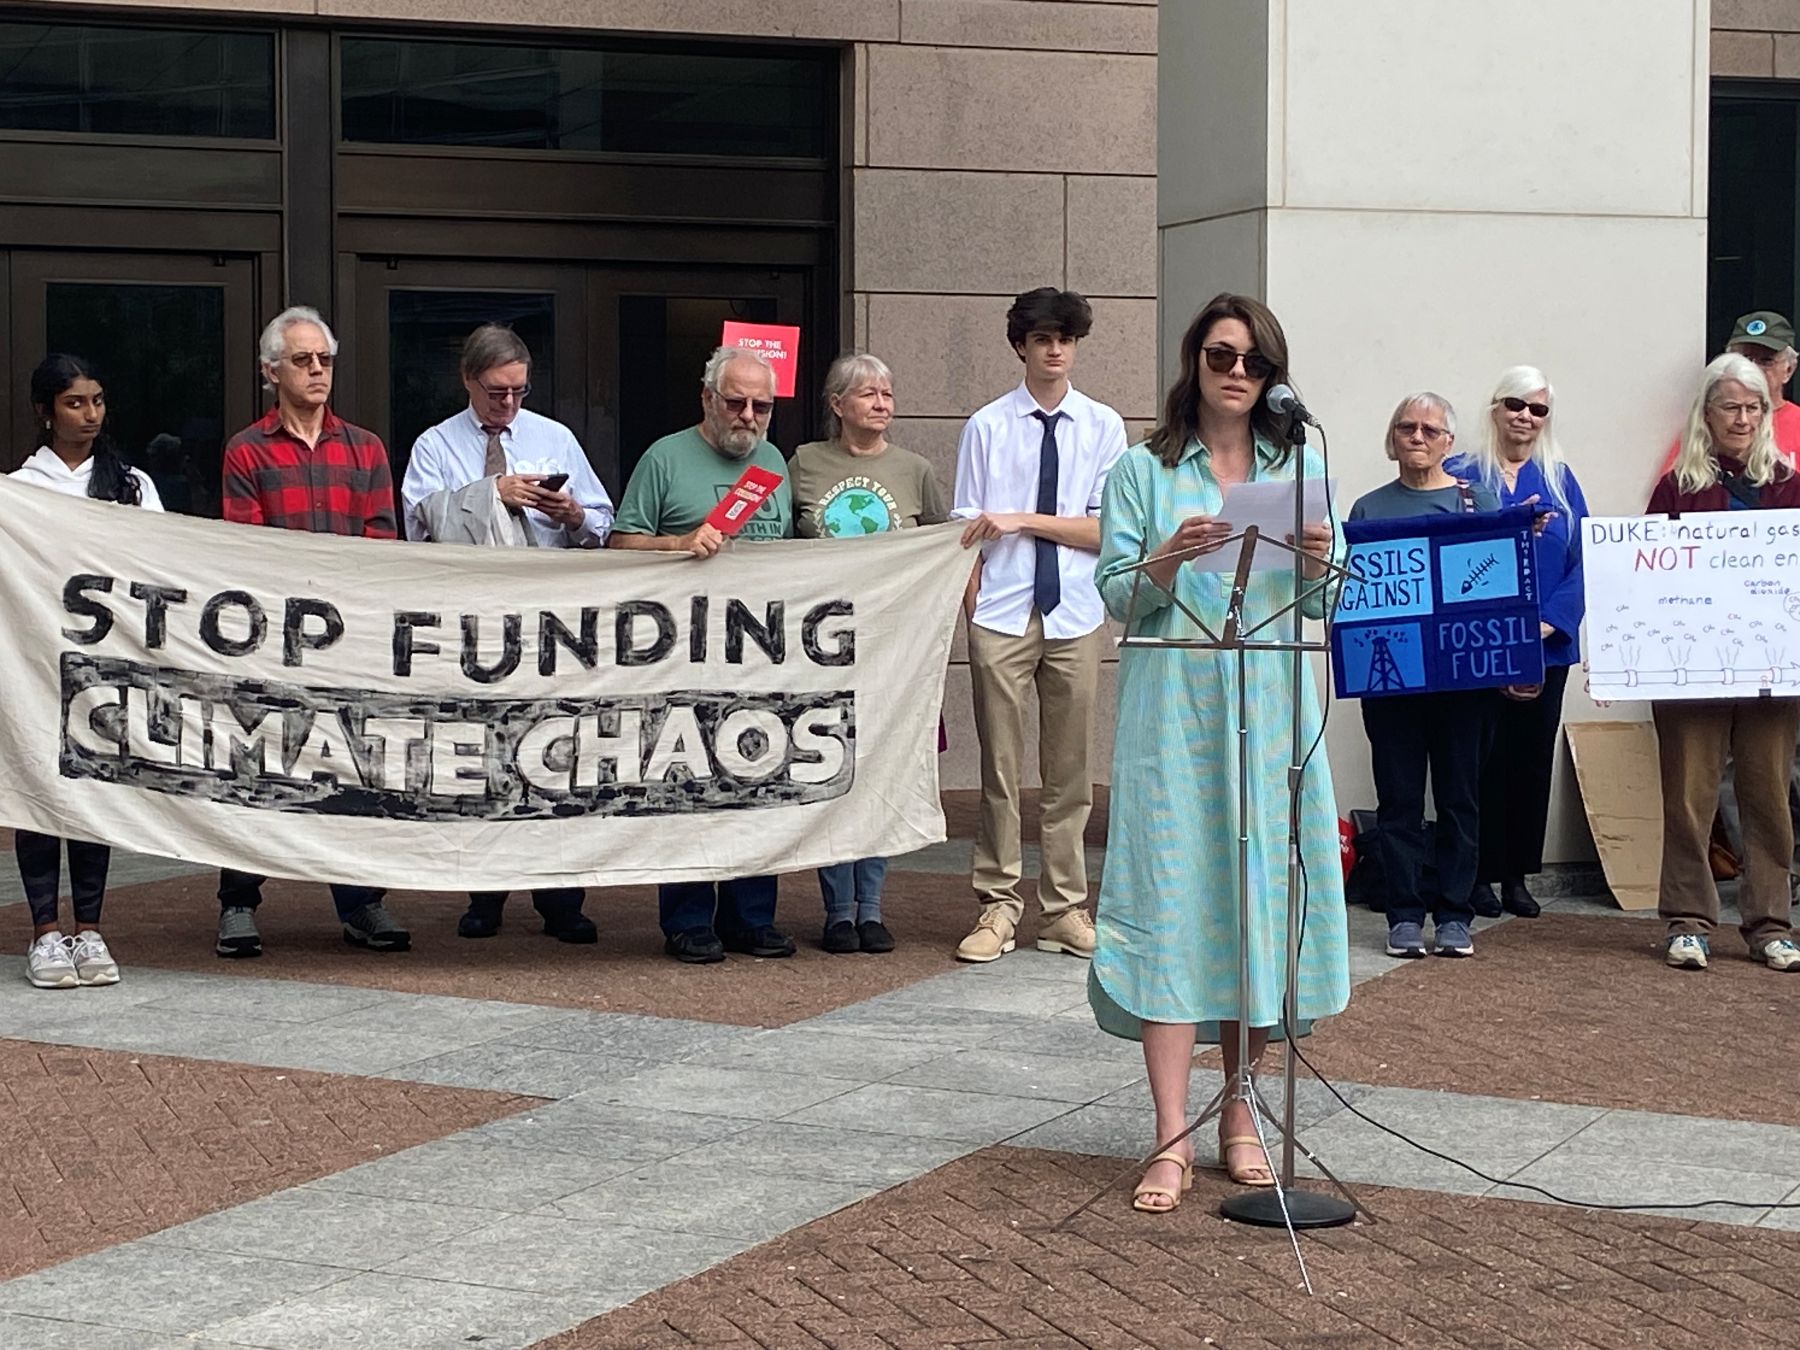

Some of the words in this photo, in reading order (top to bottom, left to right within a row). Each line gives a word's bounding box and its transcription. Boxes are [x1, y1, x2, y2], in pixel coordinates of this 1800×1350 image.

[738, 338, 763, 347] STOP
[765, 340, 782, 349] THE
[818, 476, 870, 506] RESPECT
[871, 481, 897, 511] YOUR
[1677, 520, 1757, 540] natural
[1766, 524, 1800, 545] gas
[1348, 548, 1426, 578] SSILS
[1634, 546, 1701, 572] NOT
[1709, 552, 1764, 569] clean
[1774, 552, 1799, 567] en
[1338, 577, 1425, 611] GAINST
[1658, 596, 1713, 606] methane
[62, 574, 345, 667] STOP
[392, 595, 856, 684] FUNDING
[1439, 617, 1535, 650] FOSSIL
[1452, 649, 1521, 680] FUEL
[65, 684, 487, 796] CLIMATE
[515, 704, 846, 791] CHAOS
